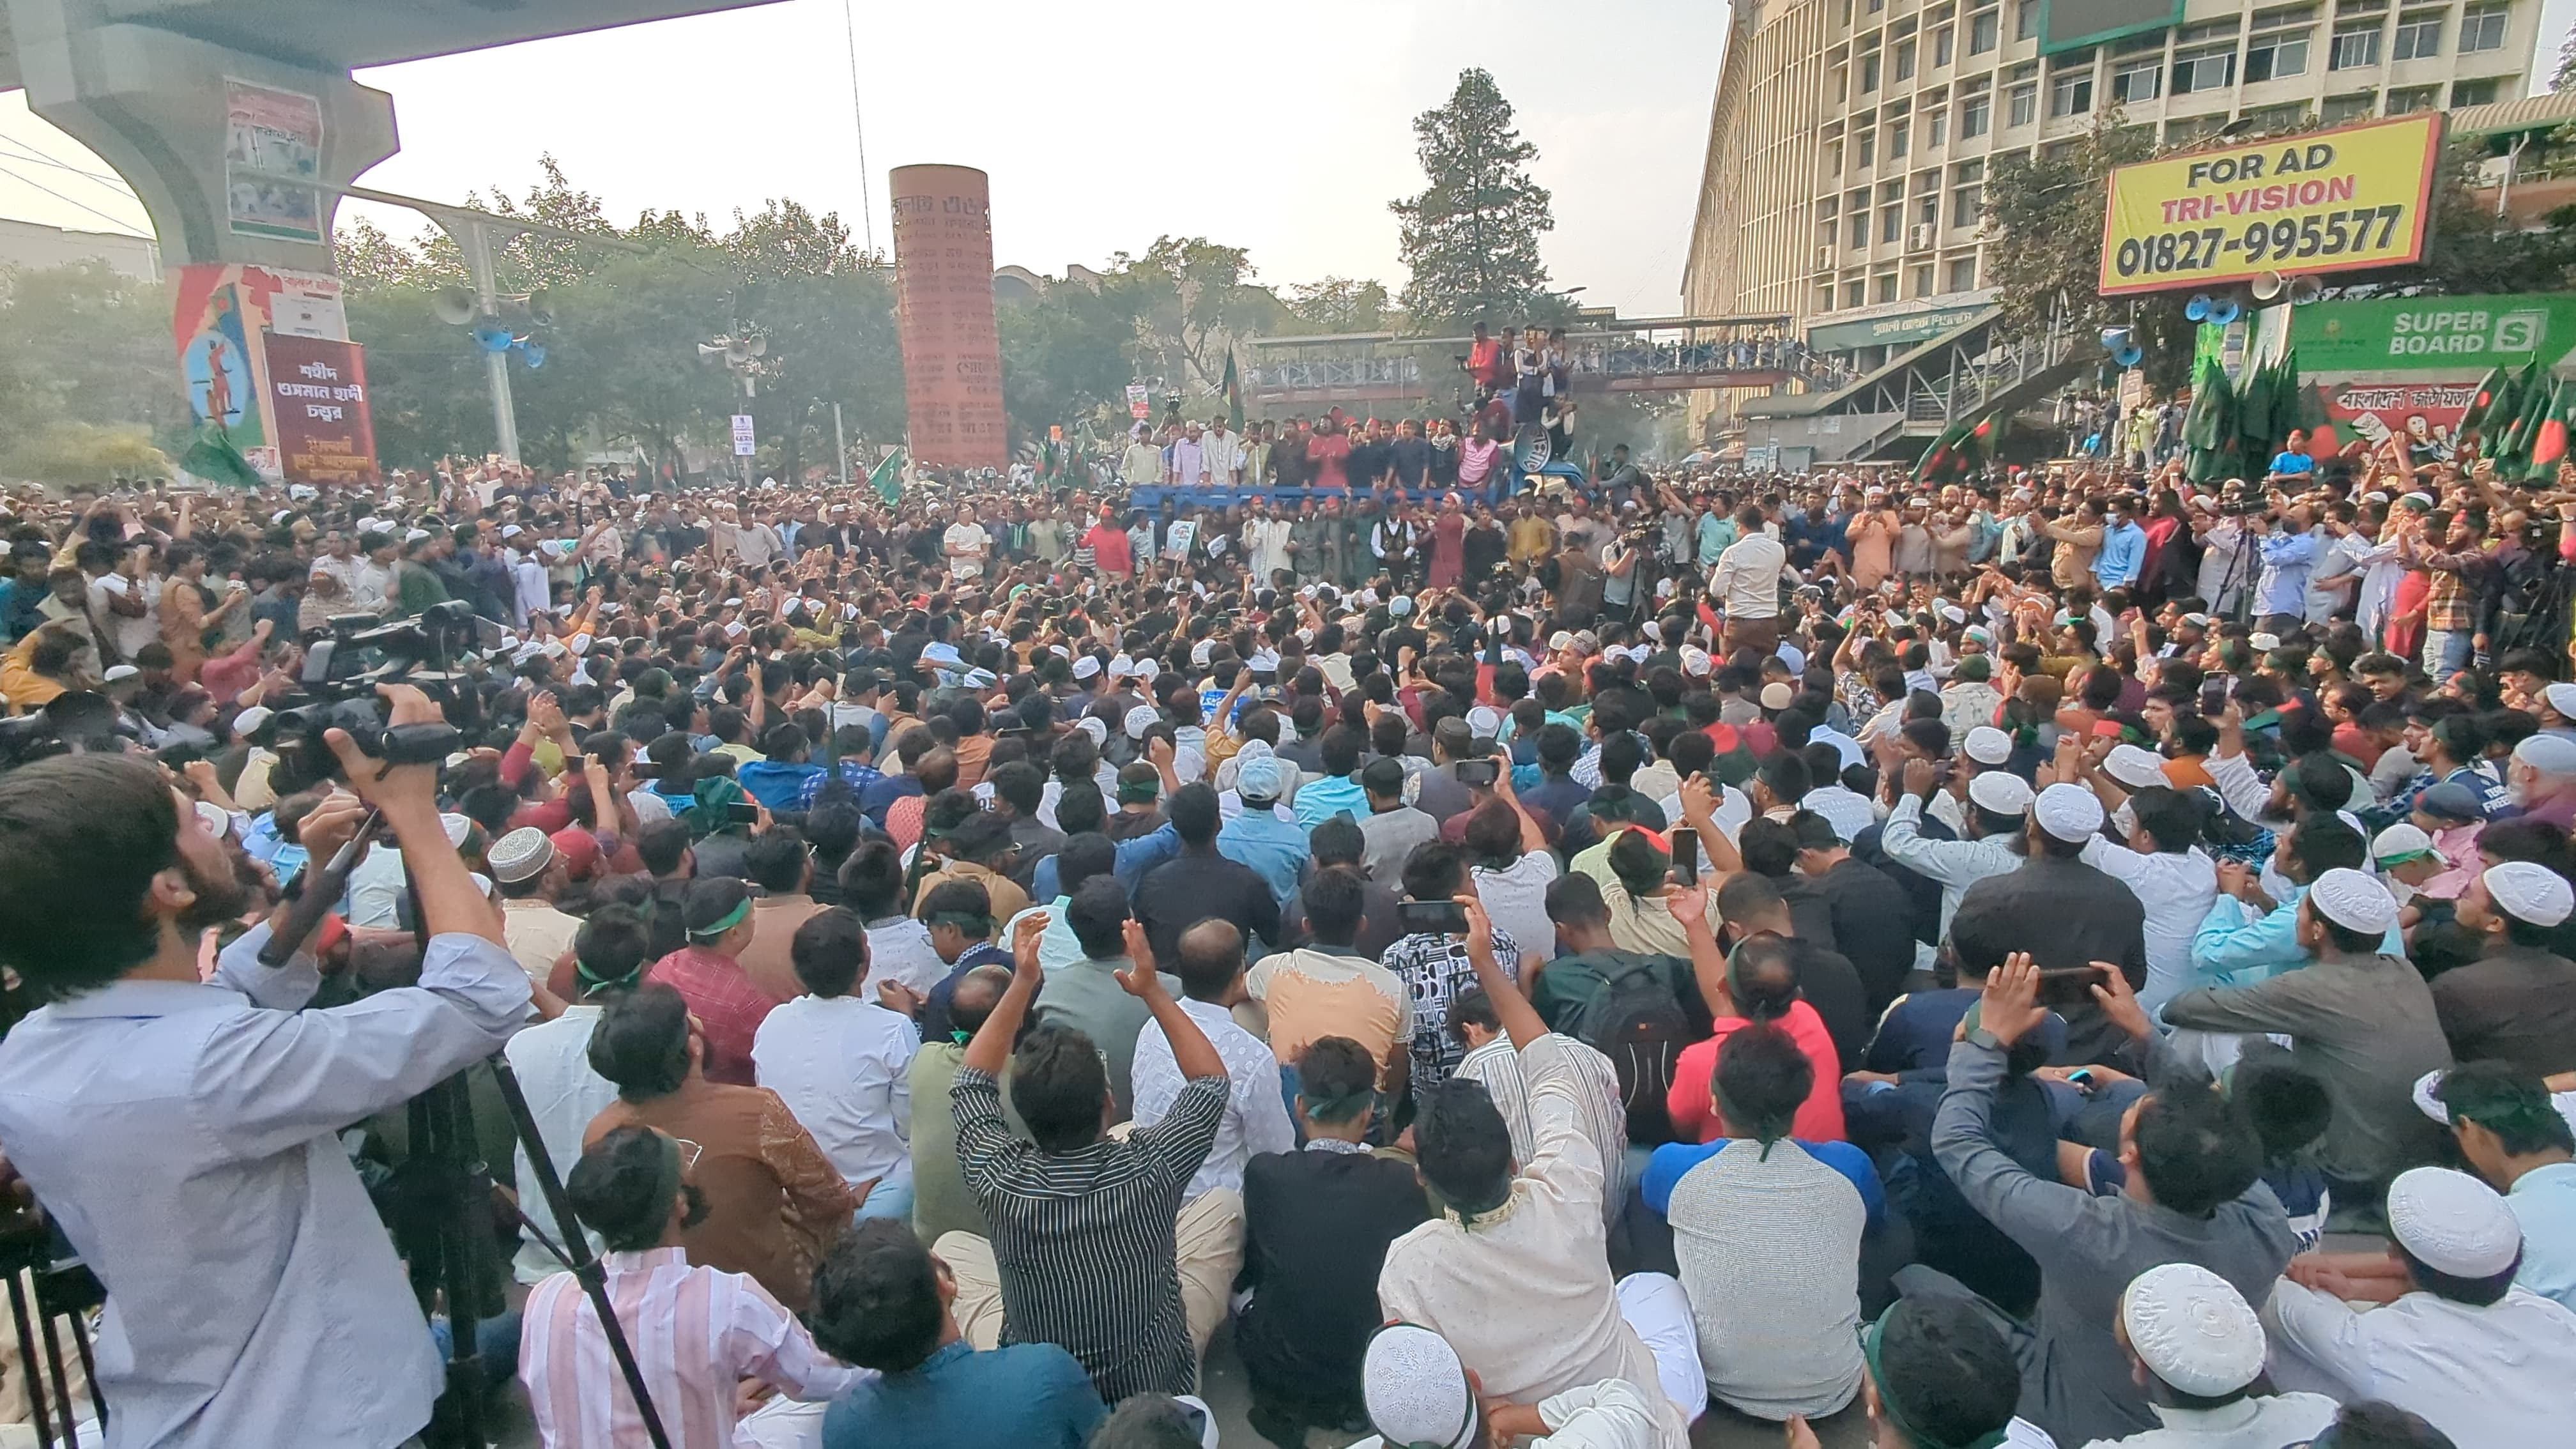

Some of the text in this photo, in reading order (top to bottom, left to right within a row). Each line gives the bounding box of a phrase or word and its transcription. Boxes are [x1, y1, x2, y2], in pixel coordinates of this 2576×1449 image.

[2188, 144, 2335, 188] FOR AD
[2161, 174, 2356, 224] TRI-VISION
[2116, 204, 2405, 278] 01827-995577
[2394, 310, 2489, 334] SUPER
[2389, 334, 2486, 355] BOARD
[298, 361, 338, 381] শহীদ
[277, 381, 363, 402] ওসমান হাদী
[2340, 386, 2476, 409] বাংলাদেশ জাতীয়তা
